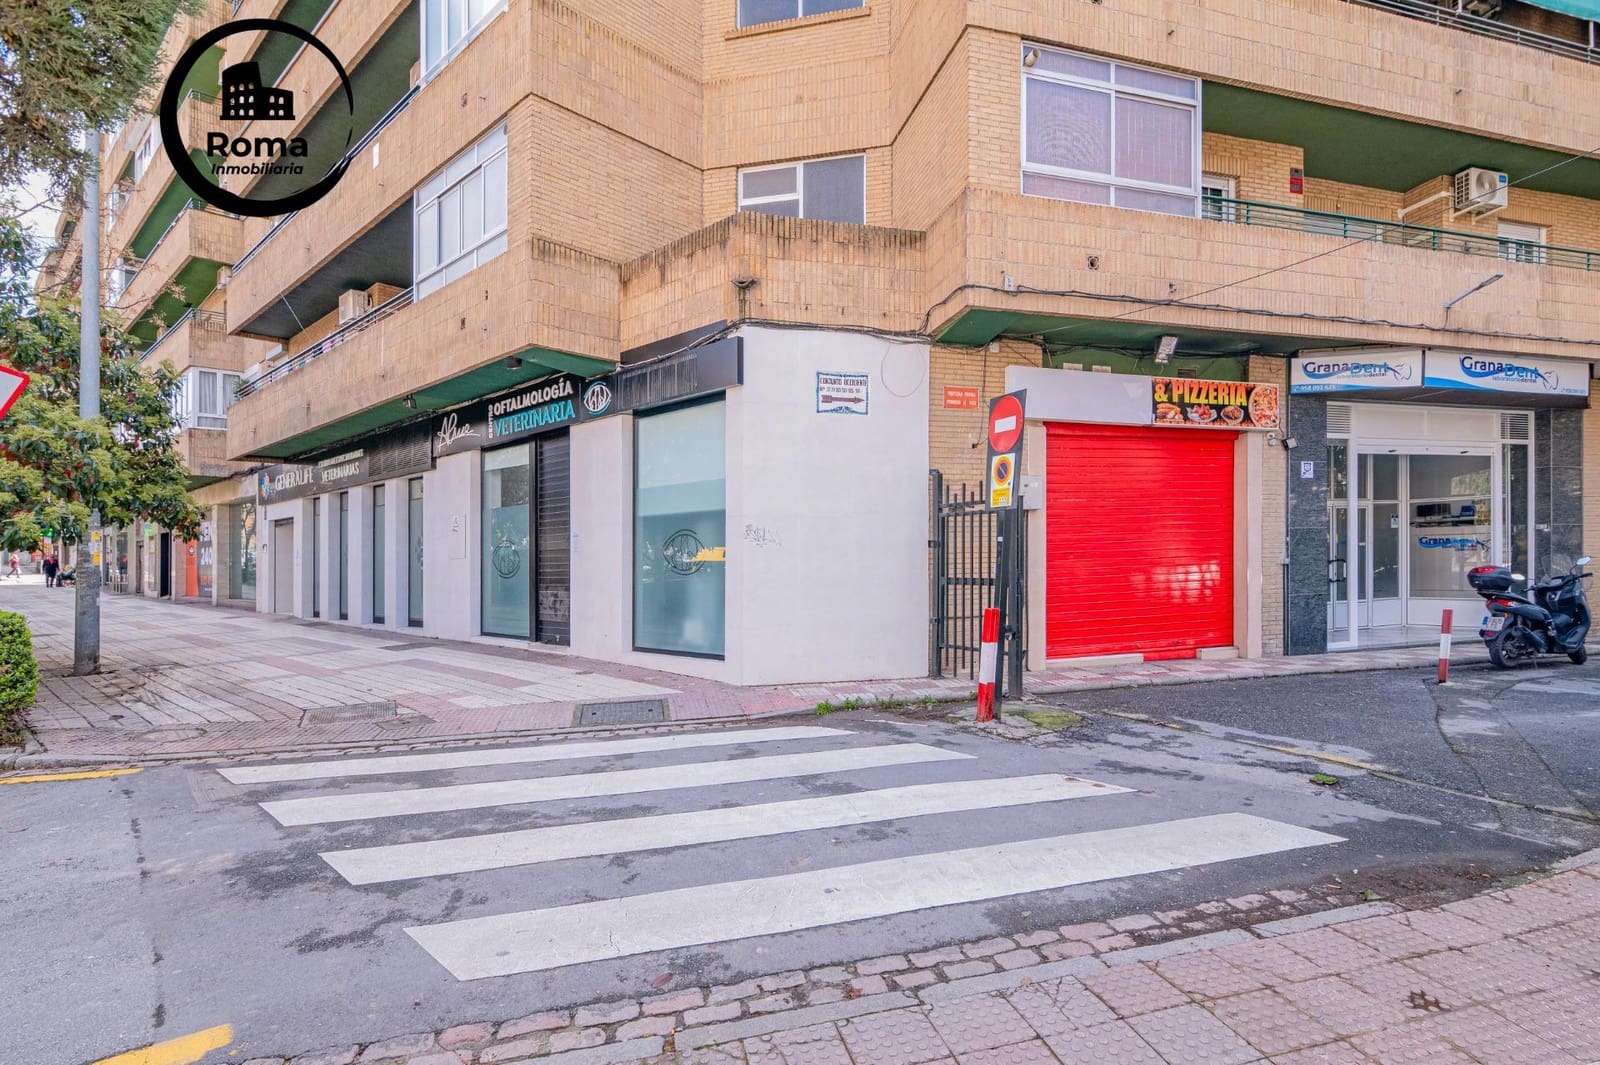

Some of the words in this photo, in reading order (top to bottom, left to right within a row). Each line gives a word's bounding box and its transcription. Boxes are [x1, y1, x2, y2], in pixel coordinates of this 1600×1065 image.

[493, 378, 573, 416] OFTALMOLOGÍA
[1154, 382, 1168, 402] &
[1171, 380, 1247, 406] PIZZERIA
[494, 400, 575, 437] VETERINARIA
